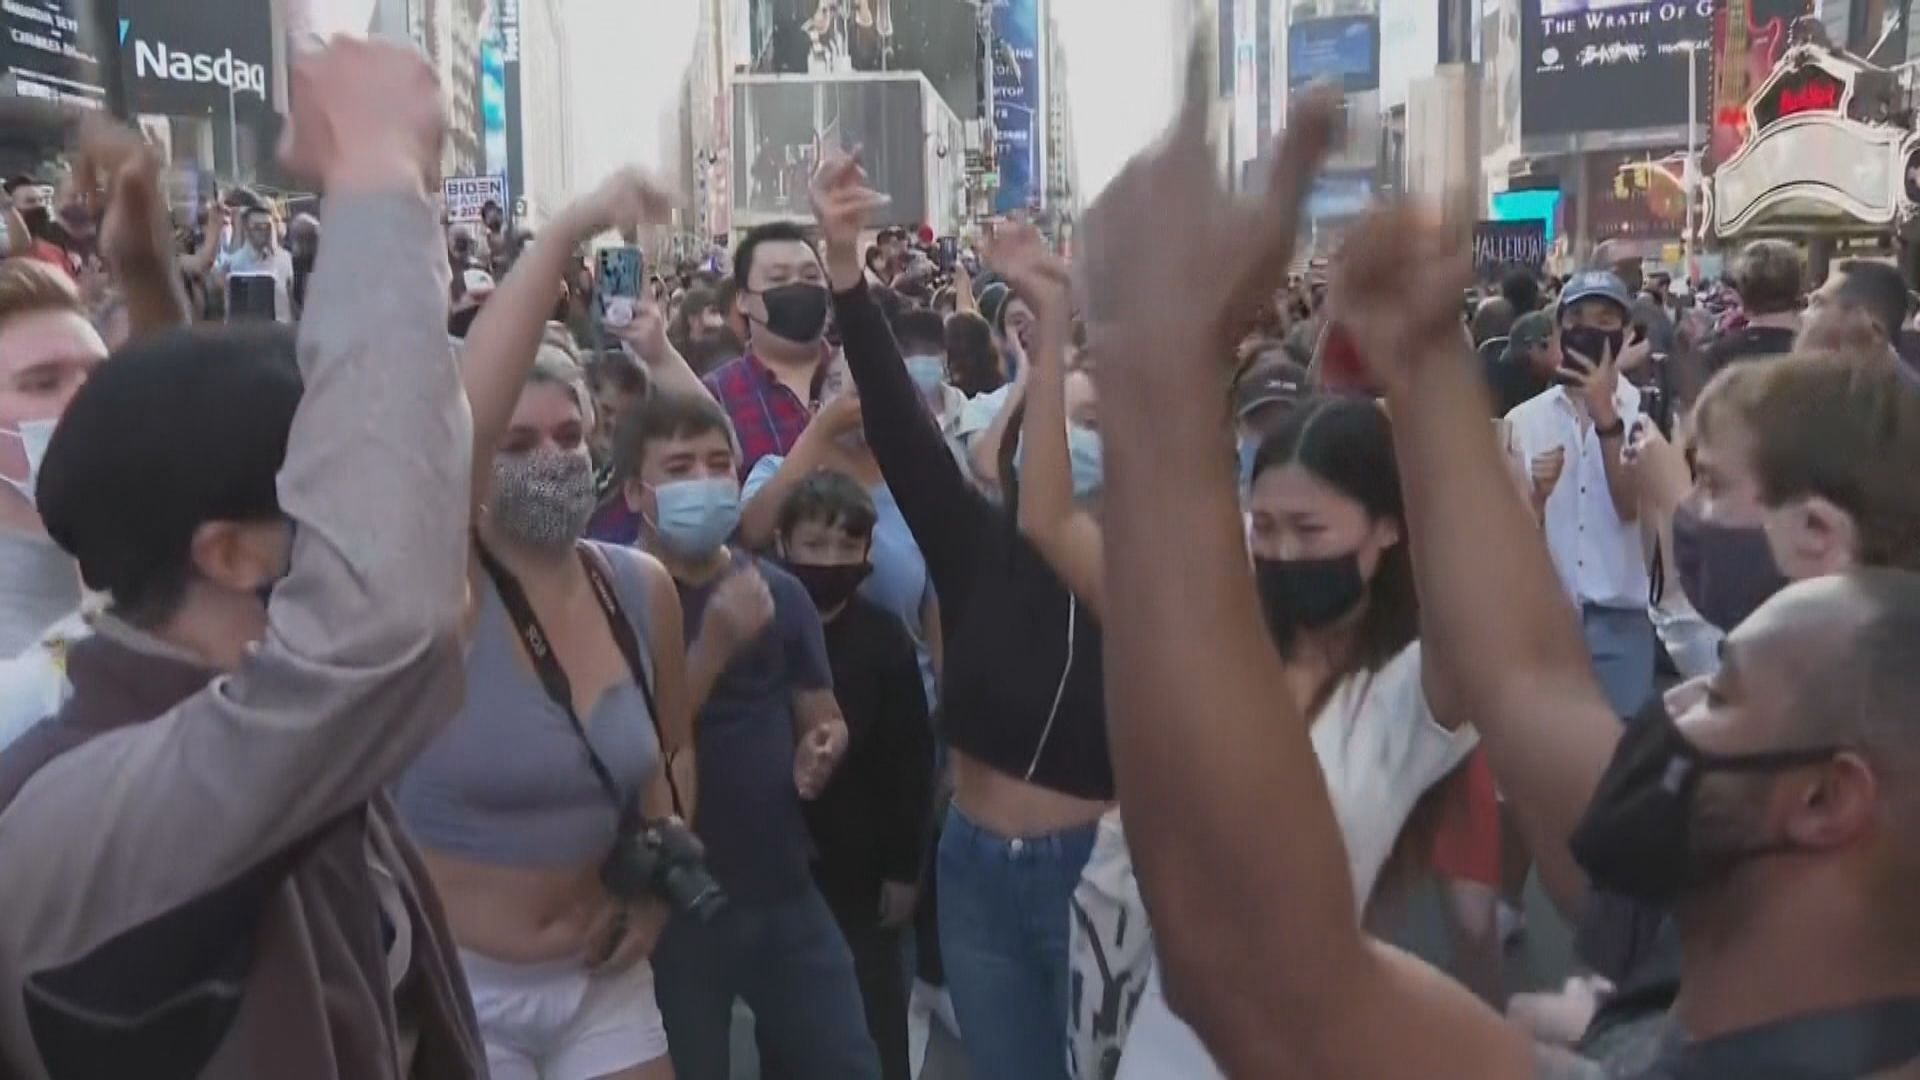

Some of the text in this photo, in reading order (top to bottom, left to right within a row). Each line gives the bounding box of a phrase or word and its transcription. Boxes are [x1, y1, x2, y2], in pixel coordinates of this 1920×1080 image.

[1541, 18, 1577, 36] THE
[1585, 11, 1650, 30] WRATH
[134, 40, 266, 101] Nasdaq
[447, 181, 501, 195] BIDEN
